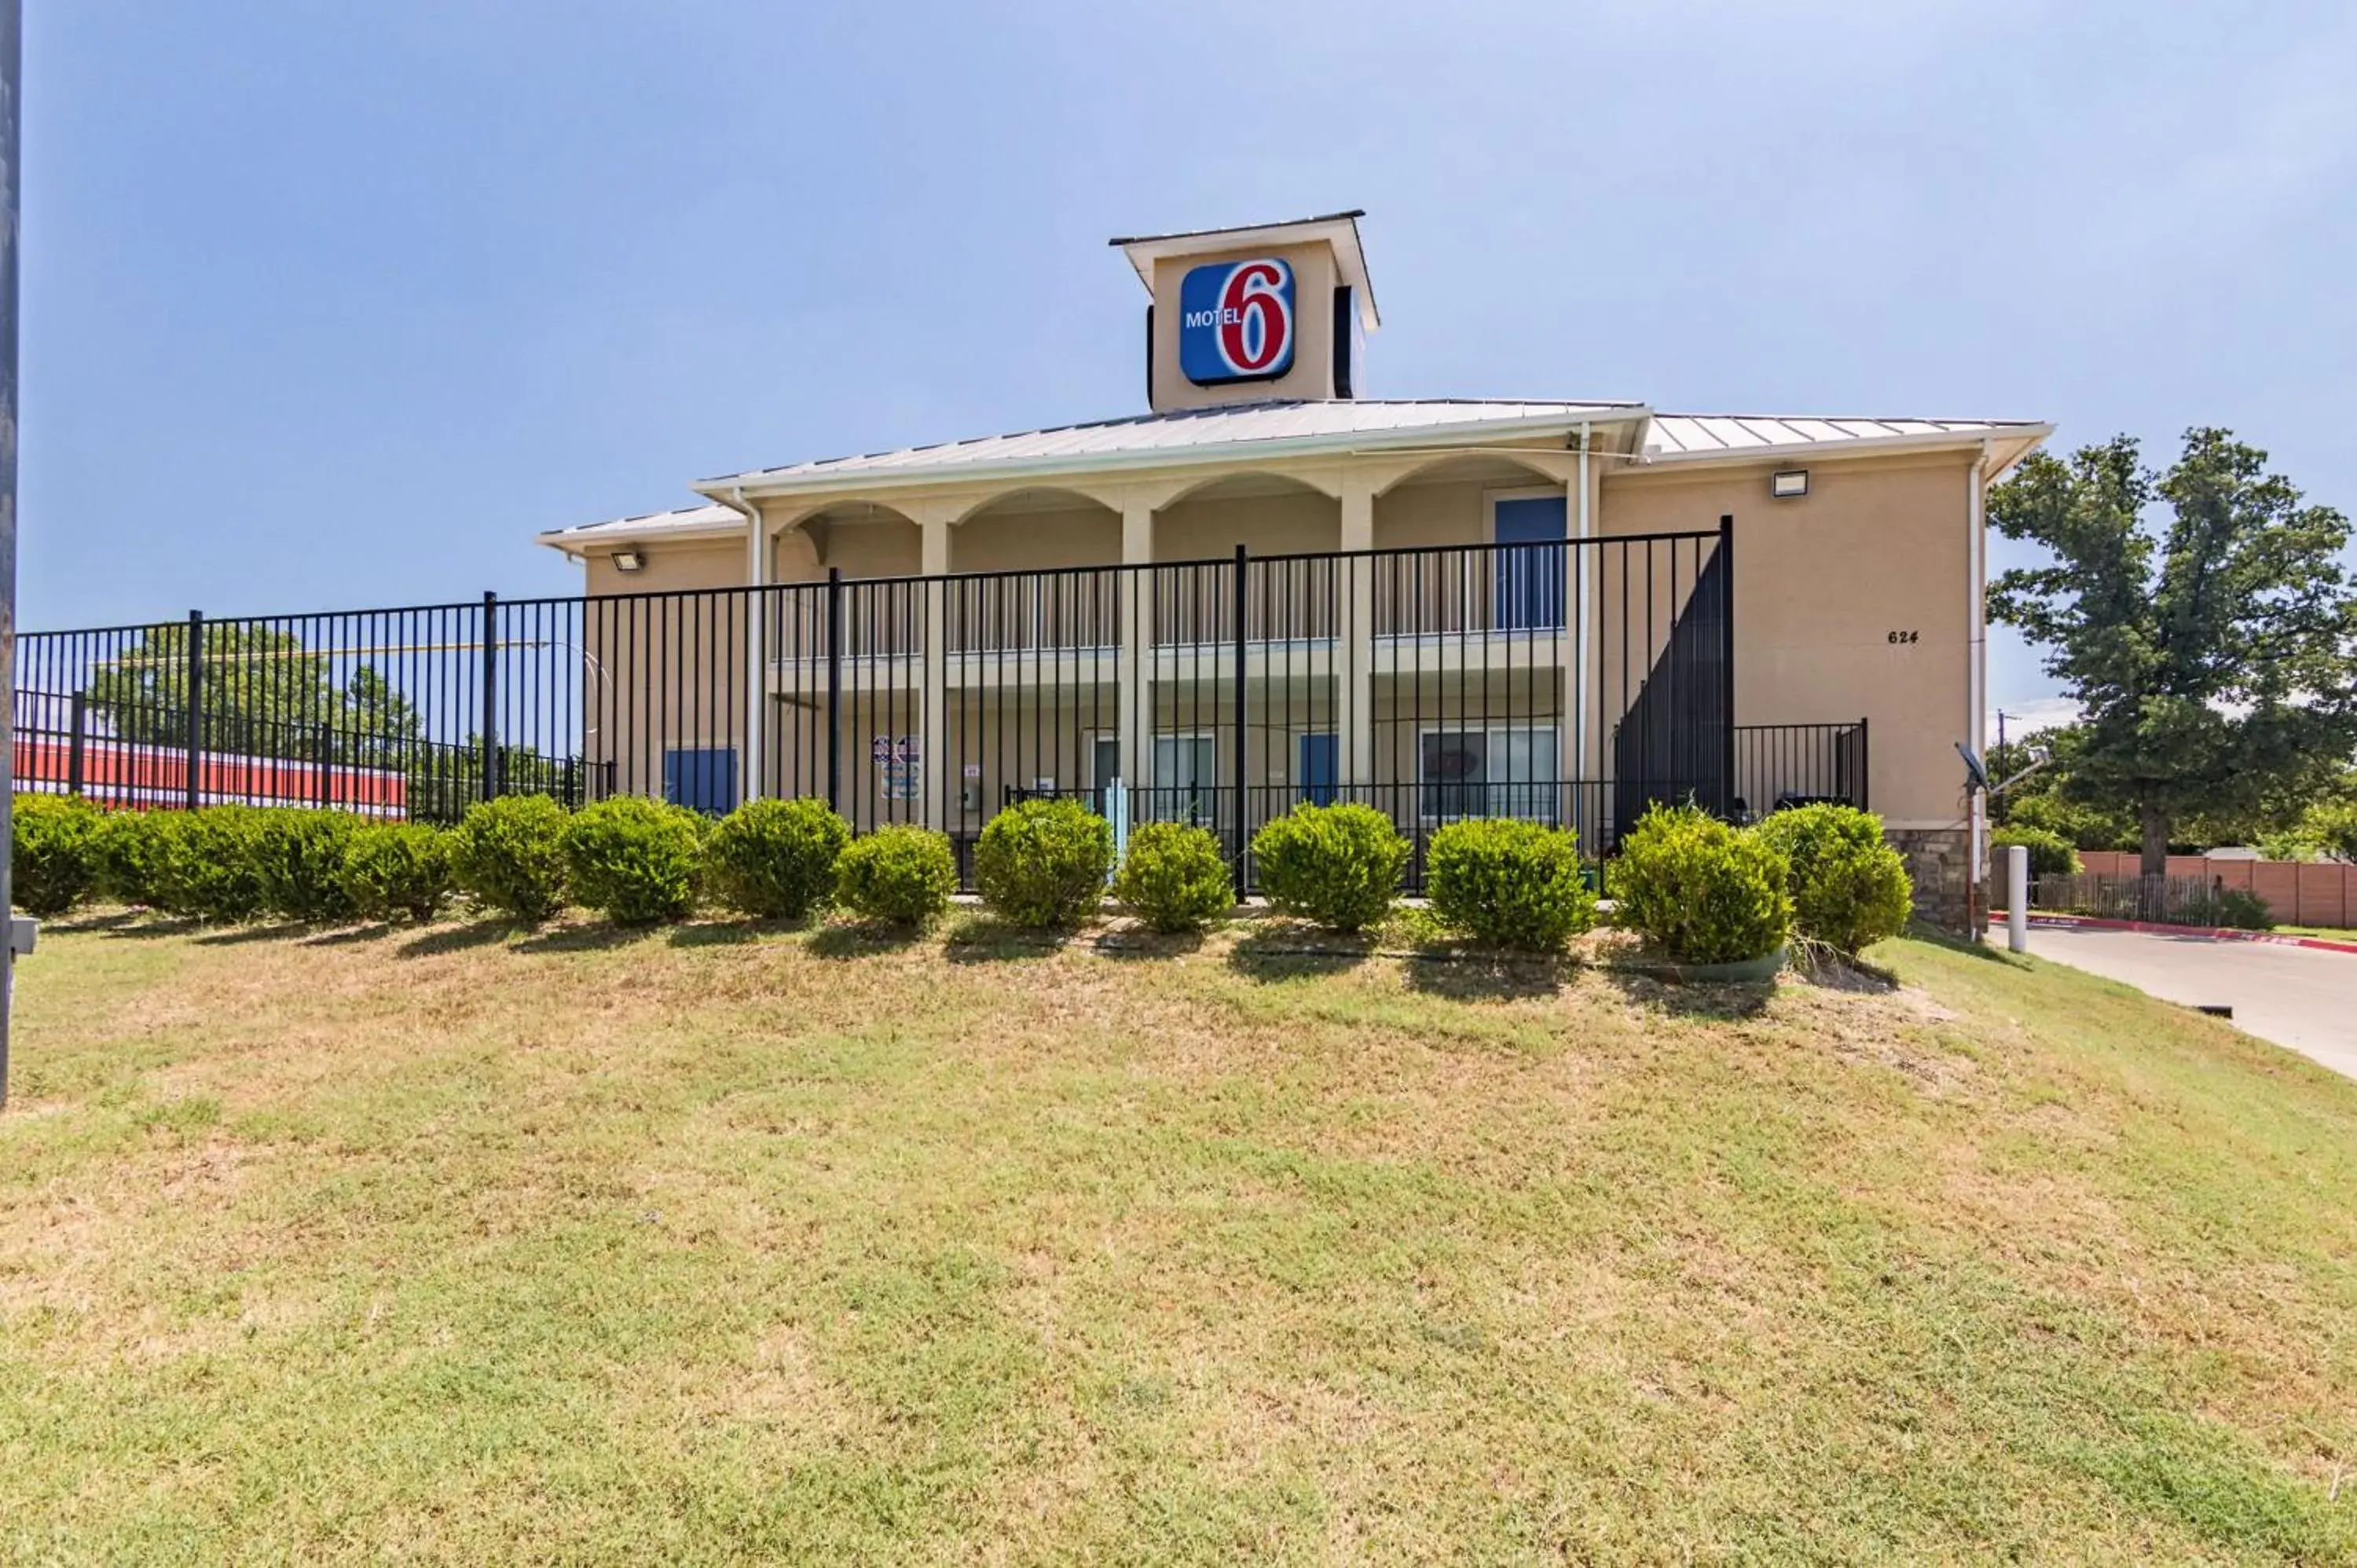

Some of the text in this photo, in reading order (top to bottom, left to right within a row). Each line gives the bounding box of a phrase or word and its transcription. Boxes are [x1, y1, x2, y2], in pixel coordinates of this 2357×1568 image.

[1186, 260, 1290, 374] MOTEL 6
[1888, 630, 1919, 643] 624
